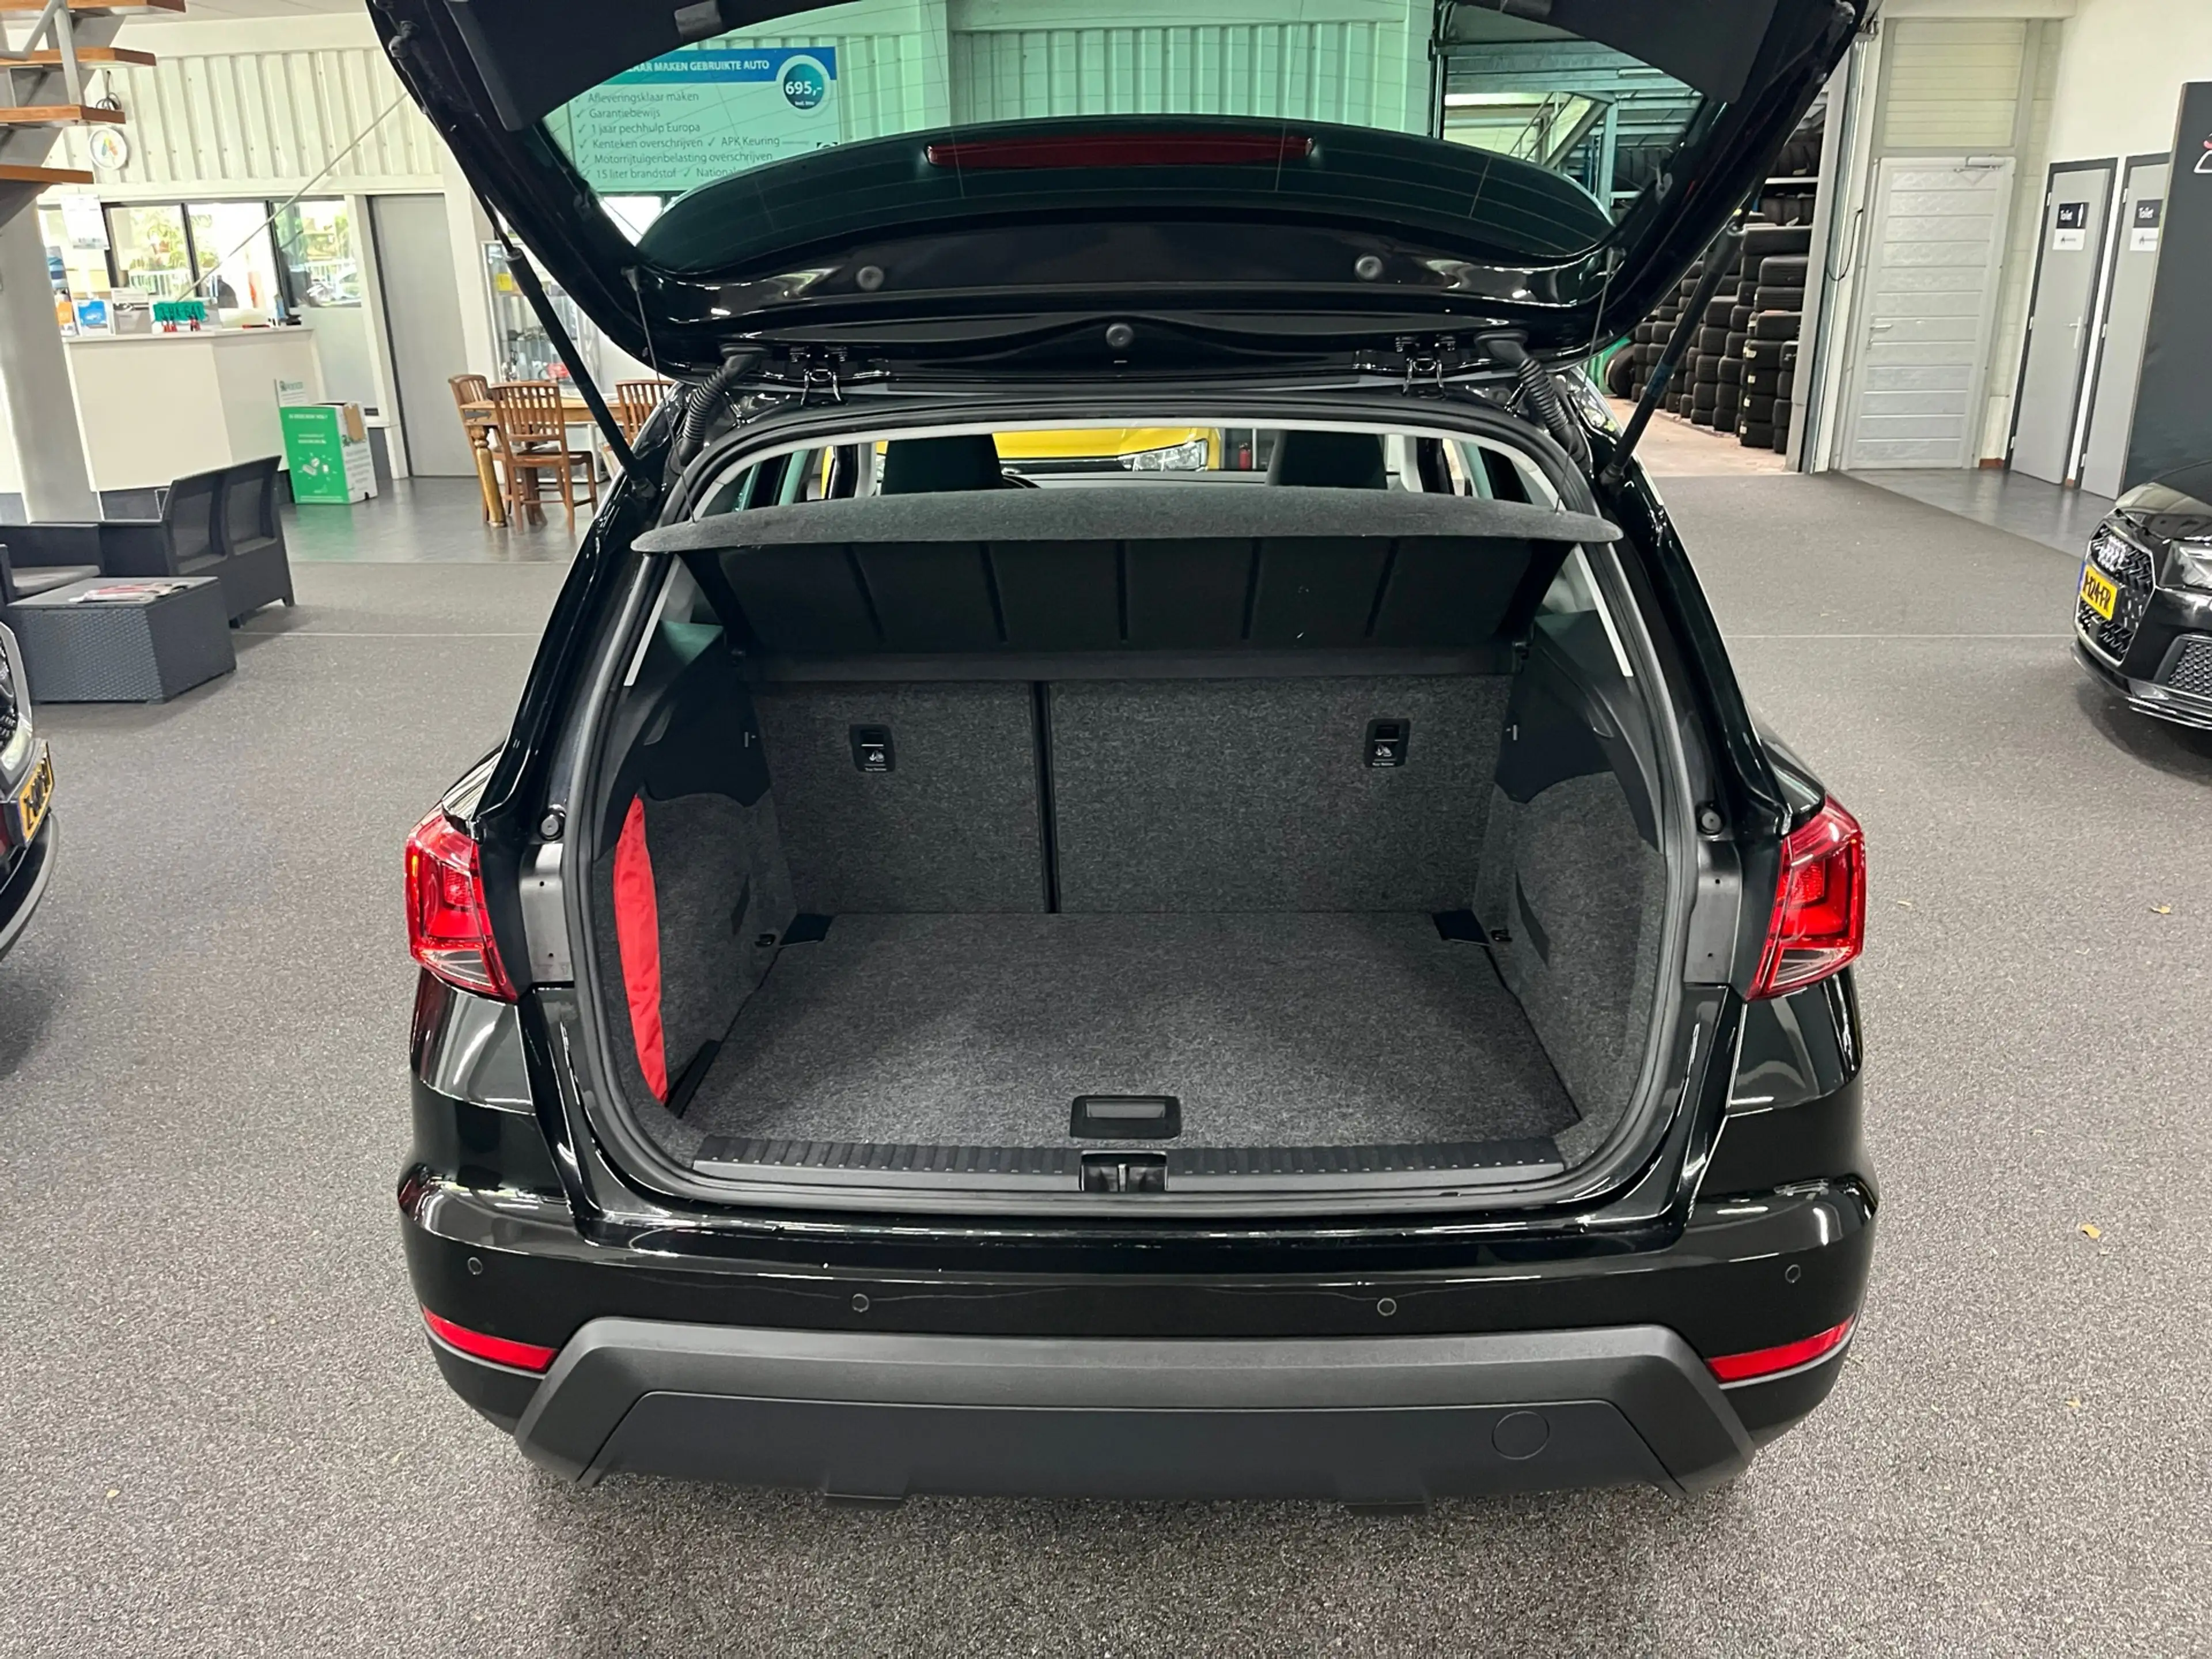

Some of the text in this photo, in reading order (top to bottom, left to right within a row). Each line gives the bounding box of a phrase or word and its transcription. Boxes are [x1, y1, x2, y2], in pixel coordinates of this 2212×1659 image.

[654, 62, 688, 72] MAKEN
[690, 60, 741, 71] GEBRUIKTE
[744, 60, 770, 70] AUTO
[785, 81, 822, 96] 695,-
[588, 92, 699, 105] Afleveringsklaar maken
[589, 108, 661, 119] Garantiebewijs
[592, 123, 700, 136] 1 jaar pechhulp Europa
[593, 137, 703, 150] Kenteken overschrijven
[721, 136, 780, 147] APK Keuring
[594, 153, 772, 166] Motorrijtuigenbelasting overschrijven
[597, 168, 676, 179] 15 liter brandstof
